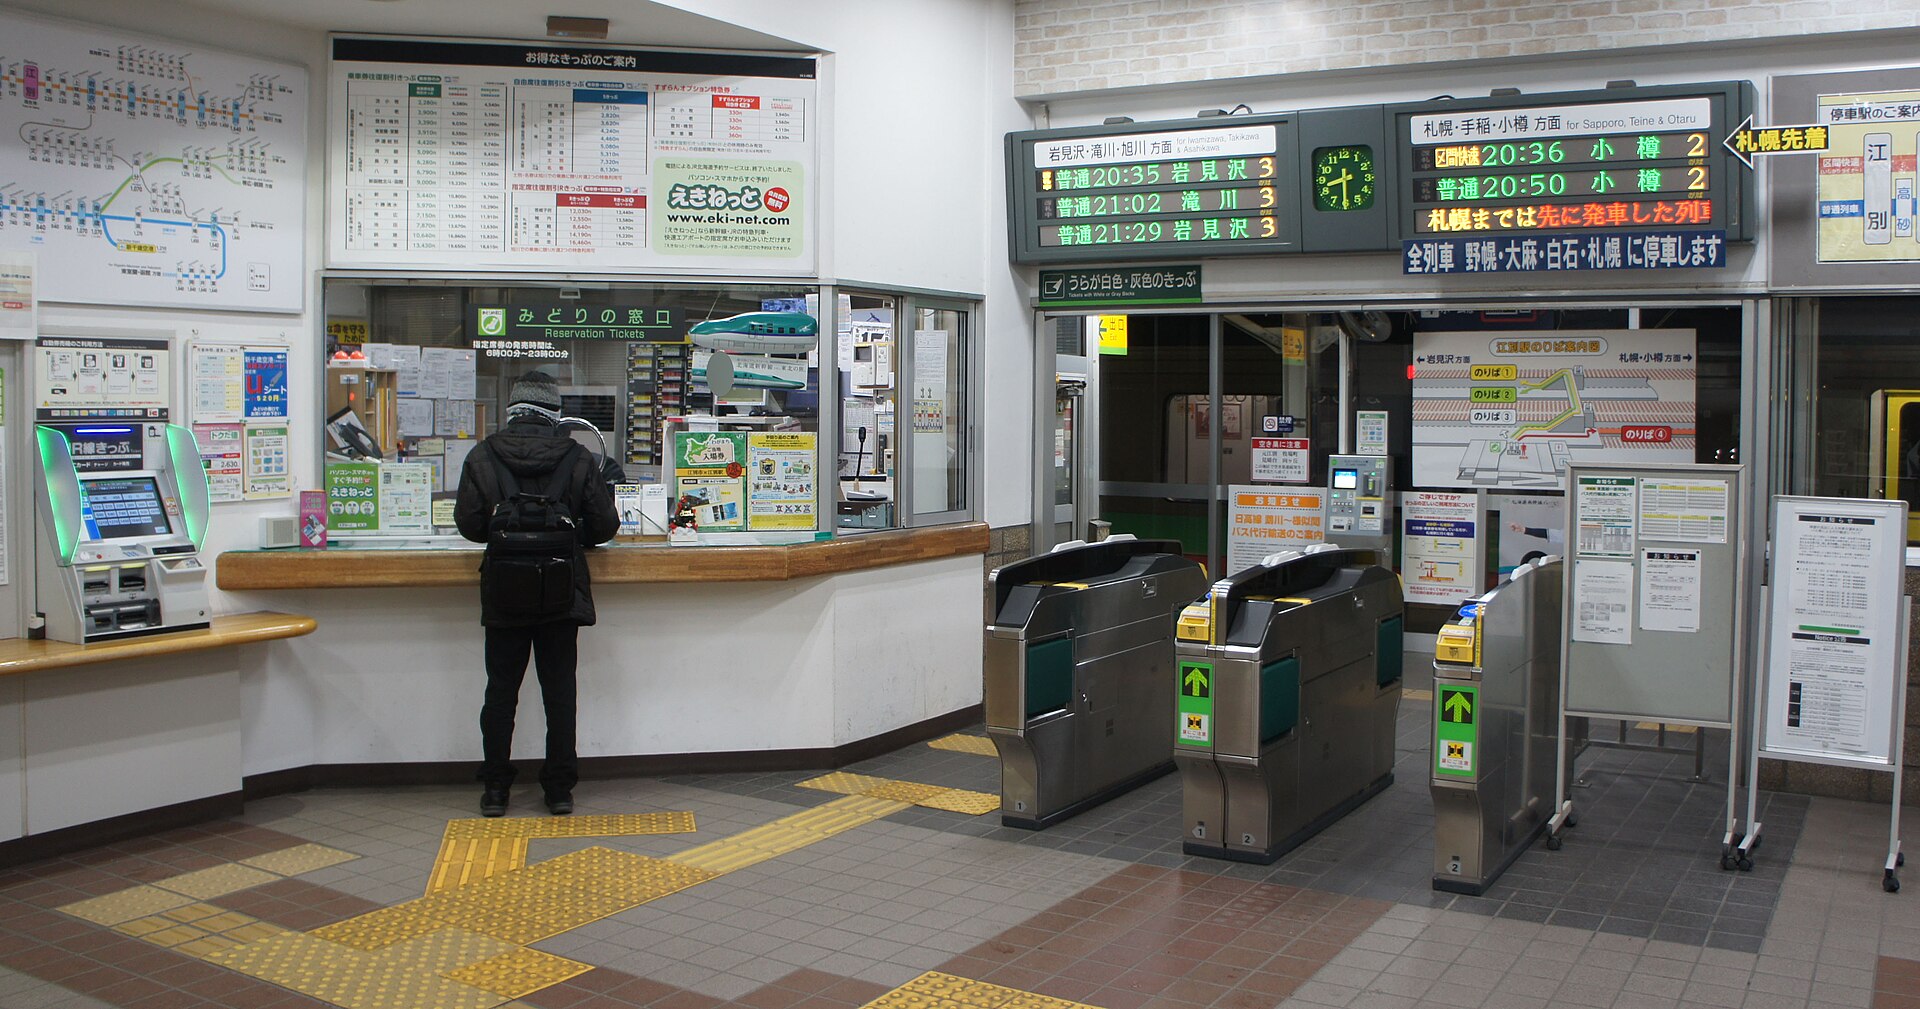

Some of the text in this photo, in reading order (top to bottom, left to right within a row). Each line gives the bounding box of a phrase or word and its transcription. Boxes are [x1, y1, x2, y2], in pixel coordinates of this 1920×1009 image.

[525, 51, 637, 68] お得なきっぷのご案内
[25, 68, 36, 97] 江別
[654, 84, 730, 93] すずらんオプション特急券
[1423, 115, 1561, 138] 札幌・手稲・小樽 方面
[1566, 114, 1696, 131] for Sapporo, Teine & Otaru
[1228, 132, 1260, 142] Takikawa
[1735, 127, 1828, 152] 札幌先着
[1049, 140, 1172, 162] 岩見沢・滝川・旭川 方面
[1183, 144, 1220, 153] Asahikawa
[1435, 133, 1705, 168] 区間快速 20:36 小樽 2
[1328, 156, 1338, 164] 11
[1339, 151, 1349, 159] 12
[1354, 154, 1358, 162] 1
[1360, 162, 1368, 170] 2
[1823, 158, 1861, 167] 区間快速
[1056, 157, 1274, 190] 普通 20:35 岩見沢 3
[1322, 166, 1332, 174] 10
[1318, 176, 1326, 184] 9
[1364, 174, 1371, 182] 3
[1436, 166, 1705, 201] 普通 20:50 小樽 2
[1867, 143, 1888, 230] 江別
[1322, 187, 1329, 195] 8
[1361, 185, 1368, 193] 4
[669, 184, 761, 210] えきねっと
[1331, 196, 1338, 204] 7
[1354, 194, 1360, 203] 5
[1057, 187, 1275, 218] 普通 21:02 滝川 3
[1821, 204, 1859, 214] 普通列車
[1897, 186, 1911, 231] 高砂
[667, 212, 790, 226] www.eki-net.com
[1058, 216, 1276, 246] 普通 21:29 岩見沢 3
[1407, 234, 1722, 273] 全列車 野幌・大麻・白石・札幌 に停車します
[1068, 271, 1197, 291] うらが白色・灰色のきっぷ
[519, 308, 670, 325] みどりの窓口
[545, 328, 645, 339] Reservation Tickets
[473, 340, 556, 350] 指定席券の発売時間は、
[1496, 341, 1600, 353] 江別駅のりば案内図
[1427, 354, 1454, 364] 岩見沢
[1619, 352, 1681, 363] 札幌・小樽 方面
[1474, 368, 1500, 377] のりば
[263, 385, 287, 394] シート
[1474, 390, 1500, 399] のりば
[1279, 416, 1292, 424] 禁煙
[1474, 412, 1500, 421] のりば
[1625, 429, 1654, 439] のりば
[331, 487, 374, 498] えきねっと
[1255, 496, 1300, 506] お知らせ
[1235, 513, 1262, 524] 日高線
[1232, 527, 1324, 540] バス代行輸送のご案内
[1653, 553, 1690, 561] お知らせ
[1017, 802, 1023, 810] 1
[1198, 827, 1203, 837] 1
[1244, 835, 1251, 844] 2
[1451, 863, 1458, 873] 2
